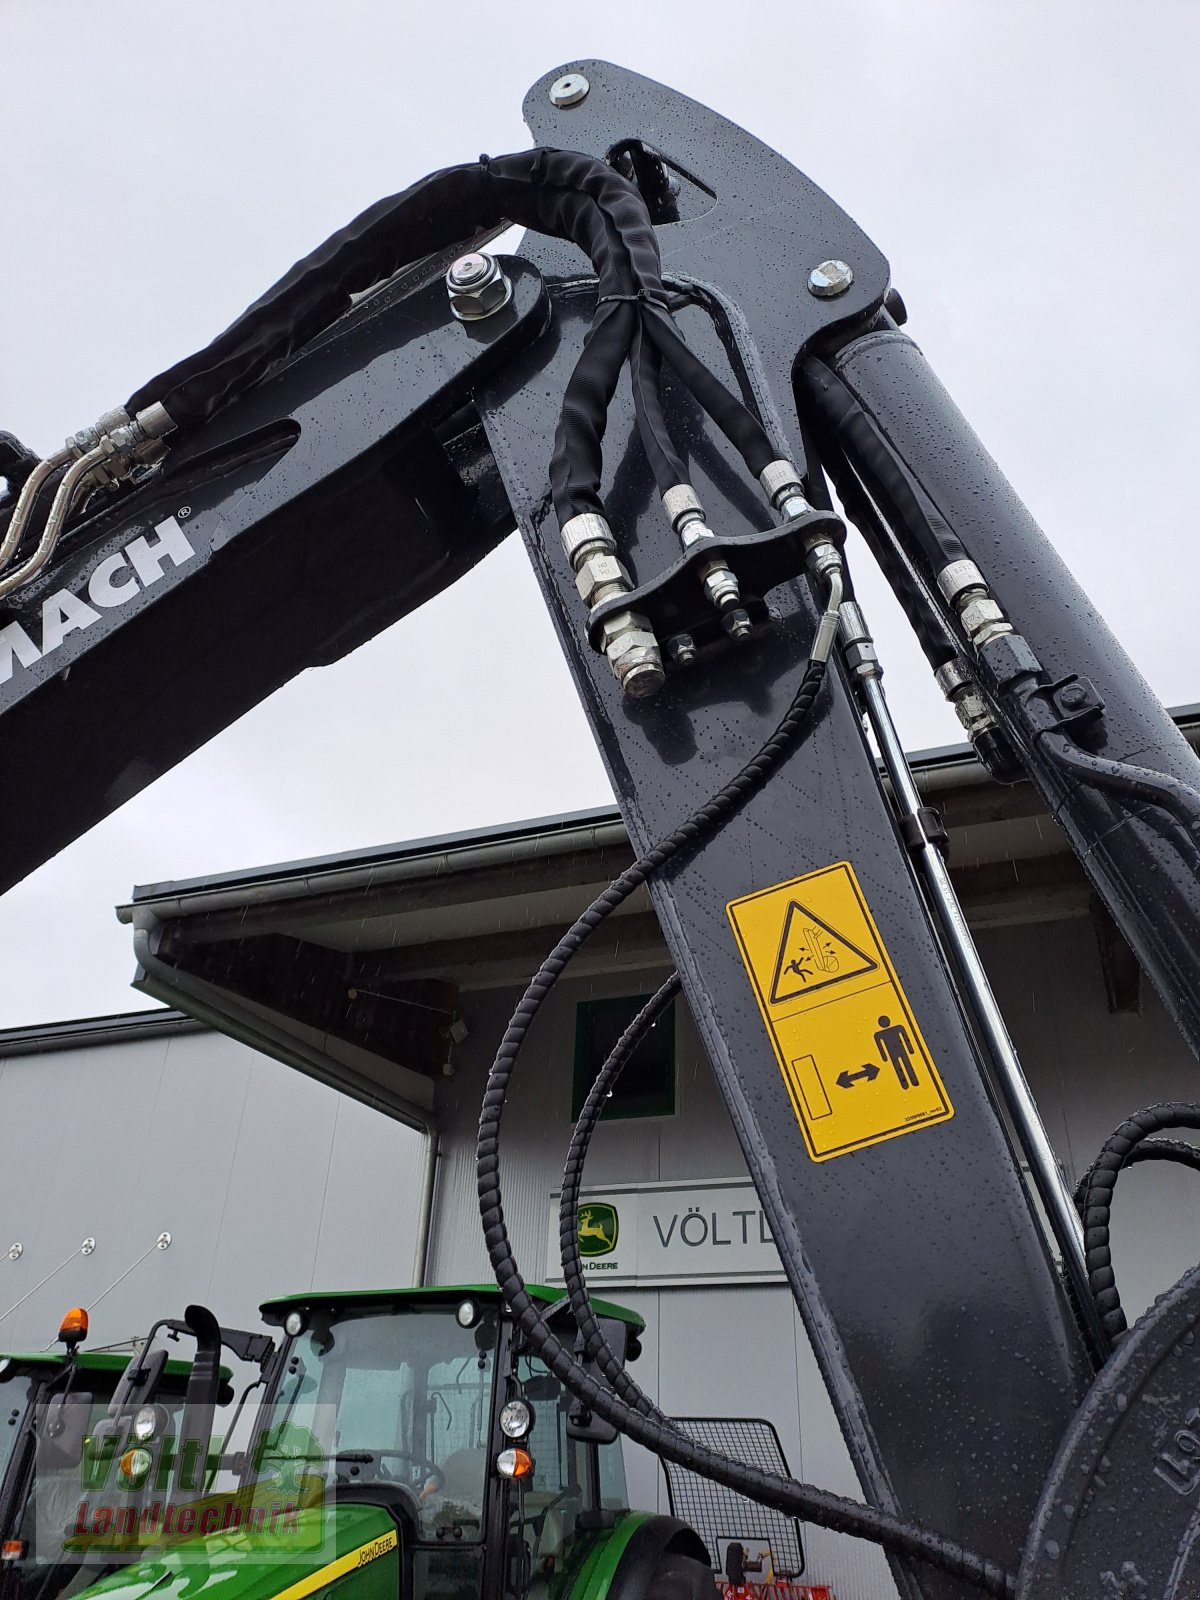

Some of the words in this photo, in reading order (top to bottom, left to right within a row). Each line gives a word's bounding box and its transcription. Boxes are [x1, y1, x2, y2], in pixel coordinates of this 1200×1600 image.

[589, 1261, 619, 1271] DEERE
[357, 1545, 375, 1566] JOHN
[374, 1536, 393, 1556] DEERE
